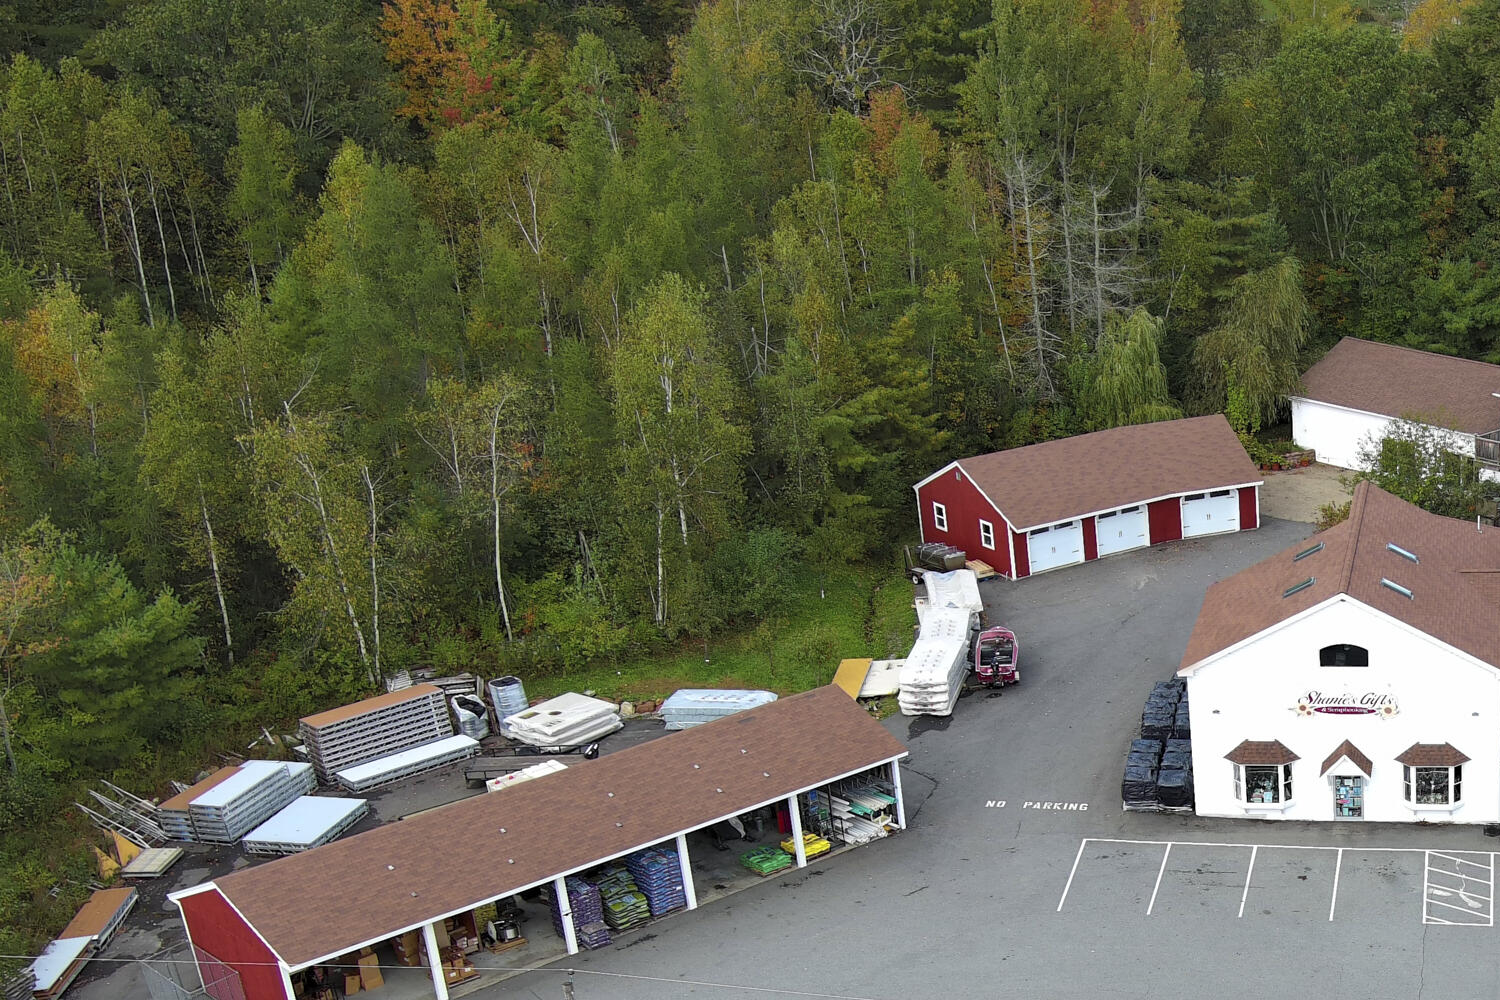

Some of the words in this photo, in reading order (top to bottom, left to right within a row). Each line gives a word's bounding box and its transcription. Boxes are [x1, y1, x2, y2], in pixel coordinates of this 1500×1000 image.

[1360, 692, 1393, 708] Gifts
[985, 800, 1007, 808] NO
[1022, 801, 1089, 811] PARKING
